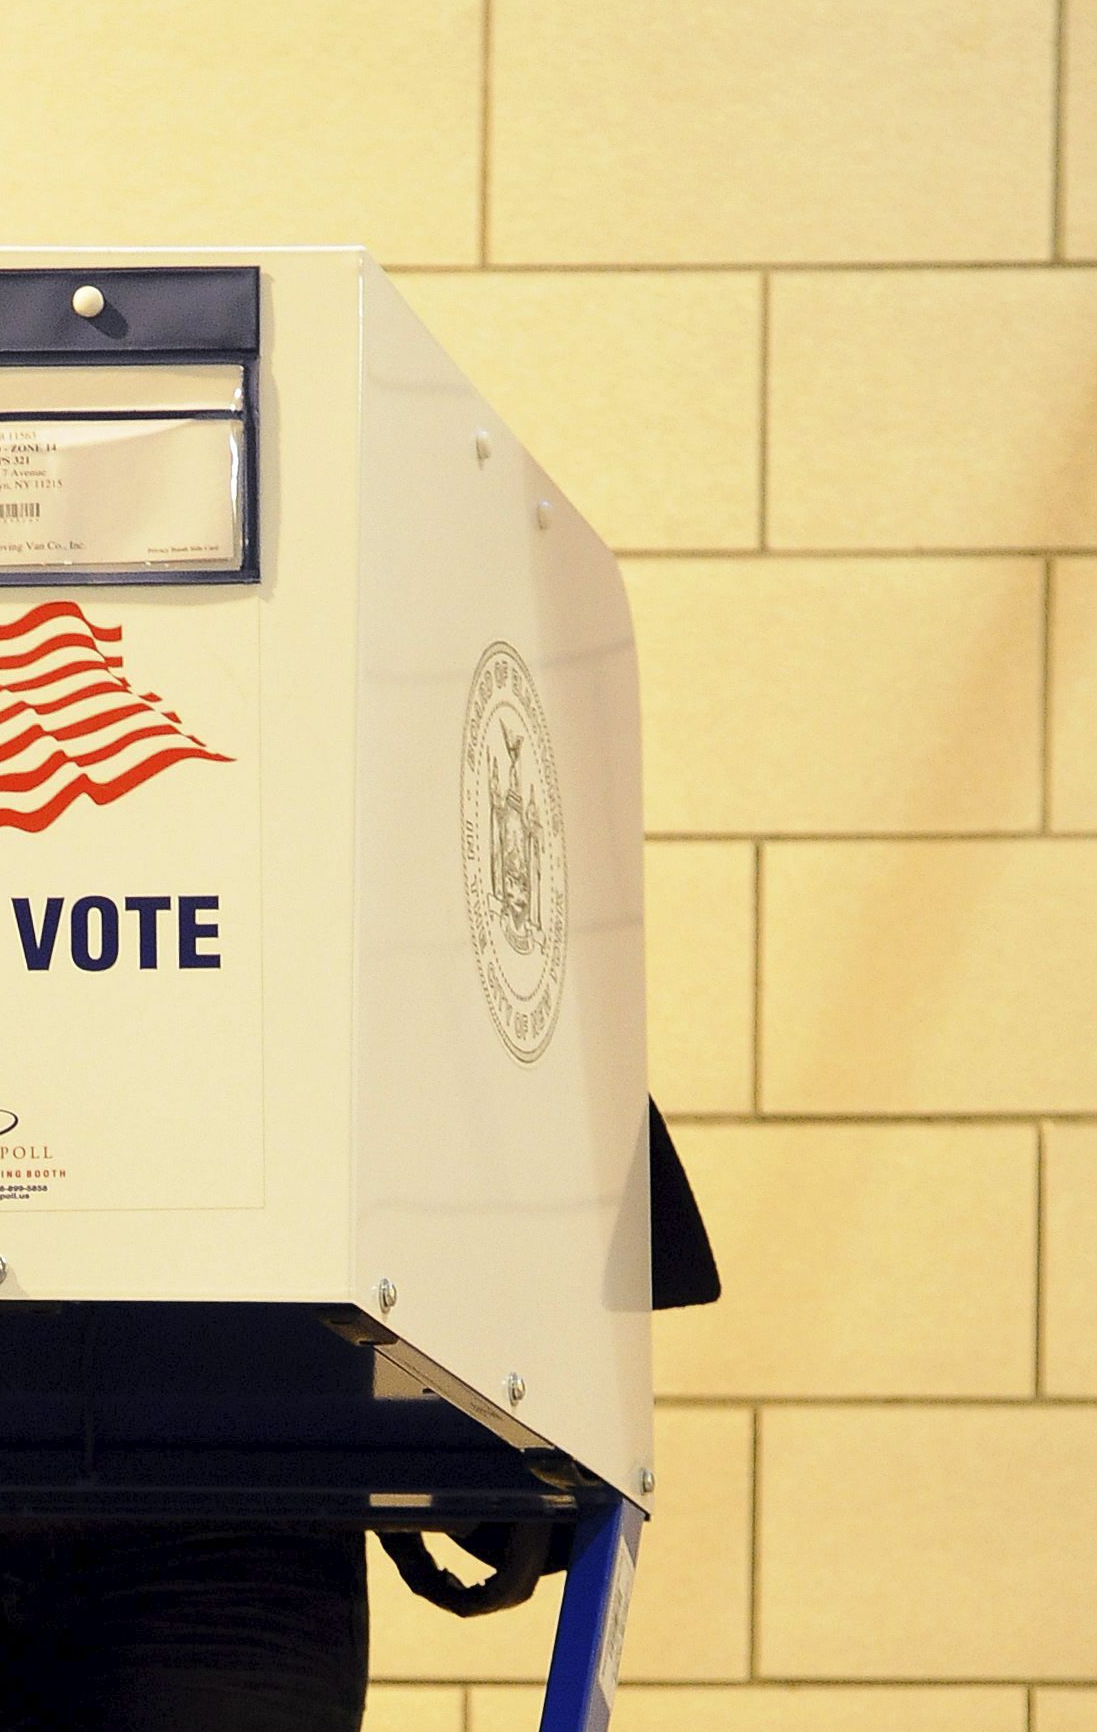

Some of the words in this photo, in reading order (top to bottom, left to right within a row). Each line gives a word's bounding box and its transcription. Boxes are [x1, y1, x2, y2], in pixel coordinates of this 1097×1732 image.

[11, 444, 43, 453] ZONE
[46, 443, 57, 452] 14
[14, 456, 30, 465] 321
[12, 469, 46, 477] Avenue
[15, 480, 30, 489] NY
[35, 479, 63, 489] 11215
[26, 541, 45, 550] Van
[11, 896, 221, 971] VOTE
[26, 1169, 66, 1178] BOOTH
